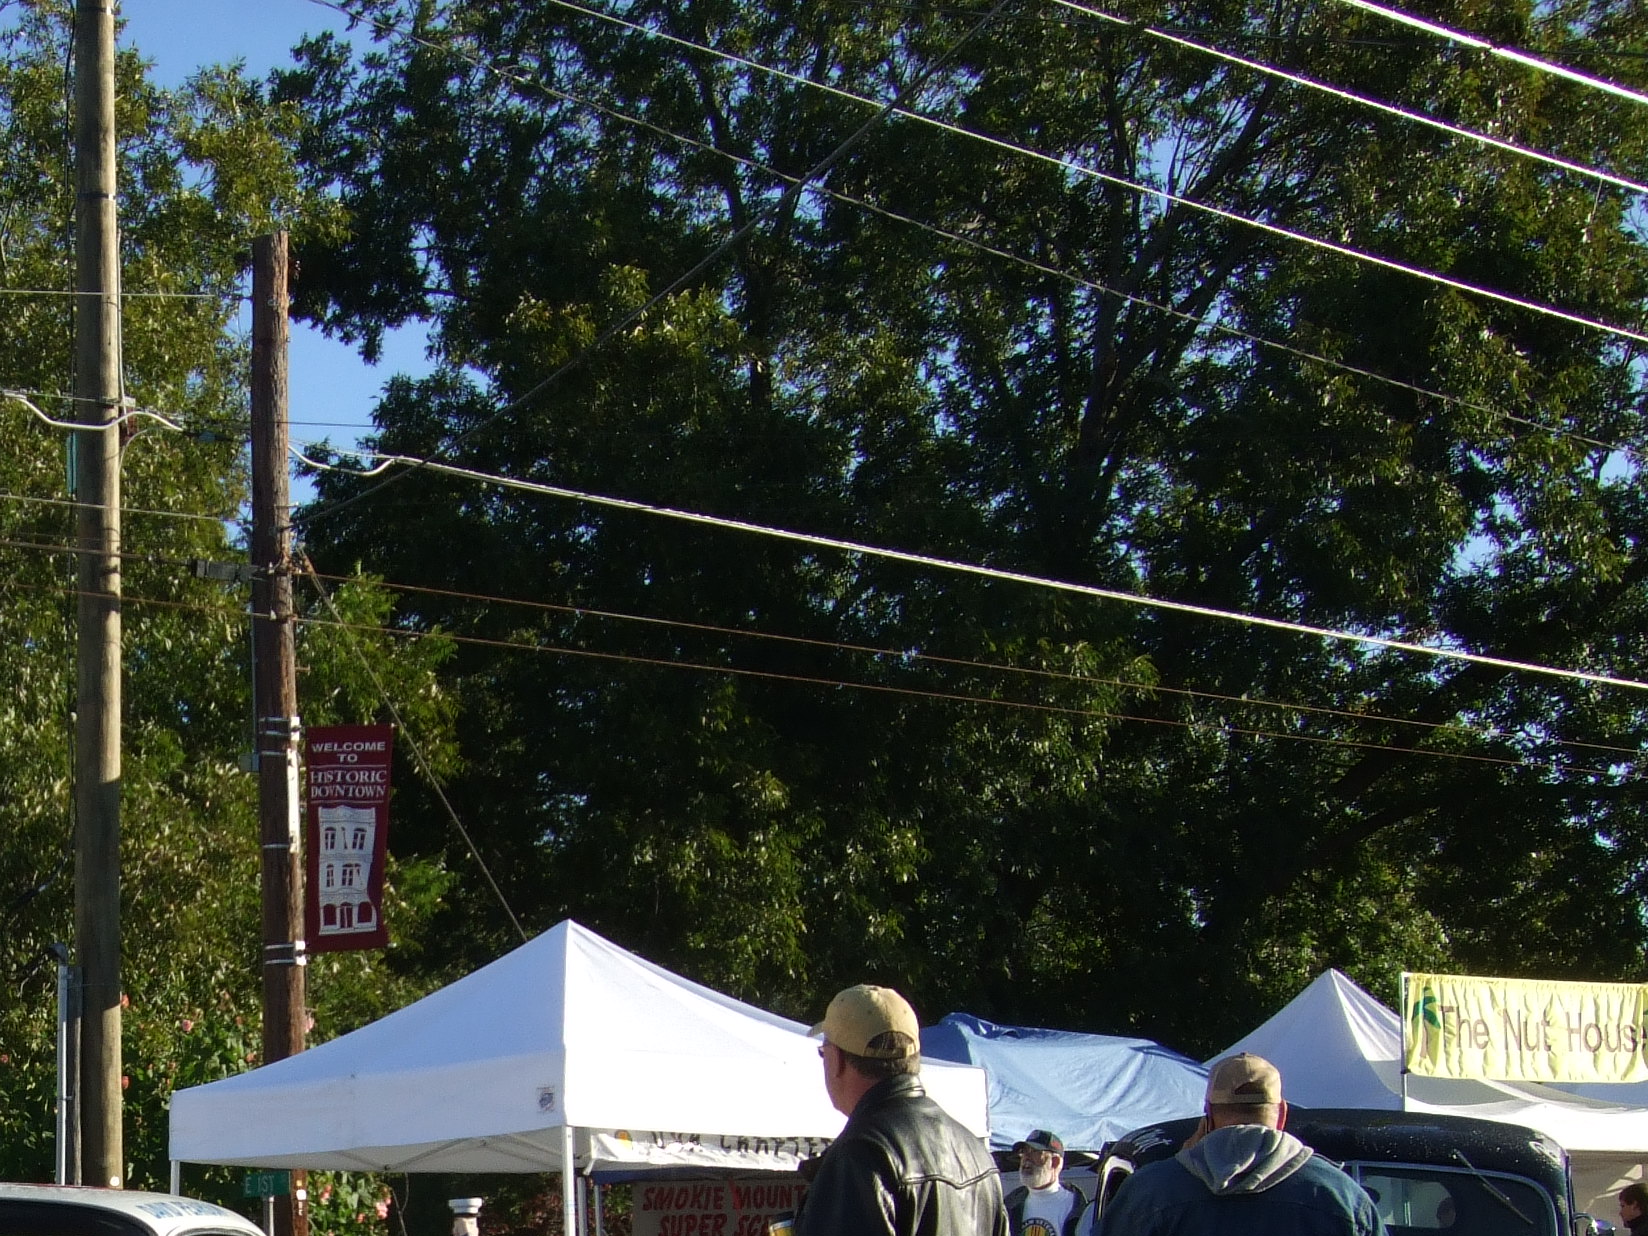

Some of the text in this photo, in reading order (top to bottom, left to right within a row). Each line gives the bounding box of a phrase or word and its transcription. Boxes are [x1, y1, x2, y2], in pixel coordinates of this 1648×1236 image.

[311, 741, 386, 752] WELCOME
[337, 753, 358, 763] TO
[310, 770, 387, 784] HISTORIC
[311, 785, 386, 798] DOWNTOWN
[1440, 1005, 1489, 1049] The
[1503, 1008, 1552, 1052] Nut
[642, 1184, 725, 1211] SMOKIE
